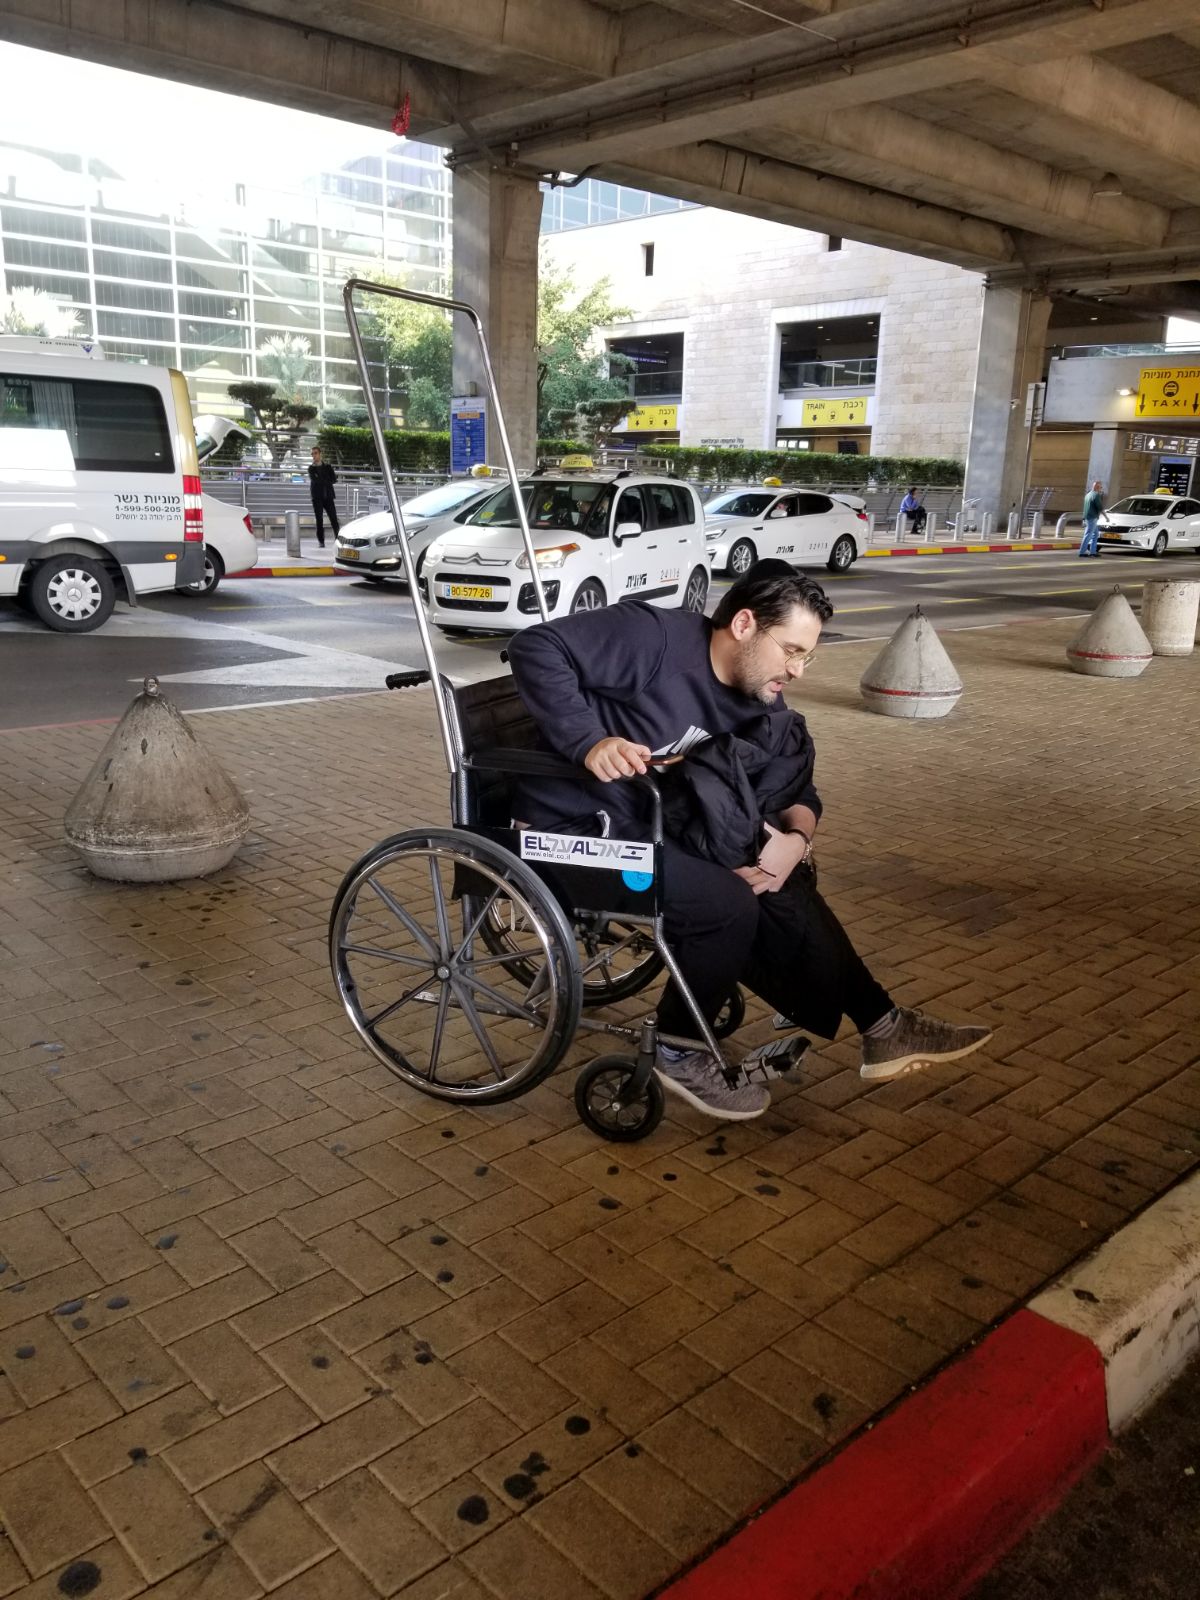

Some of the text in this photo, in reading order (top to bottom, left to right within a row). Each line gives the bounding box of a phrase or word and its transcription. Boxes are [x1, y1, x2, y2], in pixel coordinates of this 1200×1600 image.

[1143, 371, 1172, 379] מוניות
[1152, 399, 1187, 407] TAXI
[114, 494, 181, 504] מוניות נשר
[115, 505, 182, 513] 1-599-500-205
[524, 835, 599, 856] EL AL
[525, 850, 571, 861] www.elal.co.il
